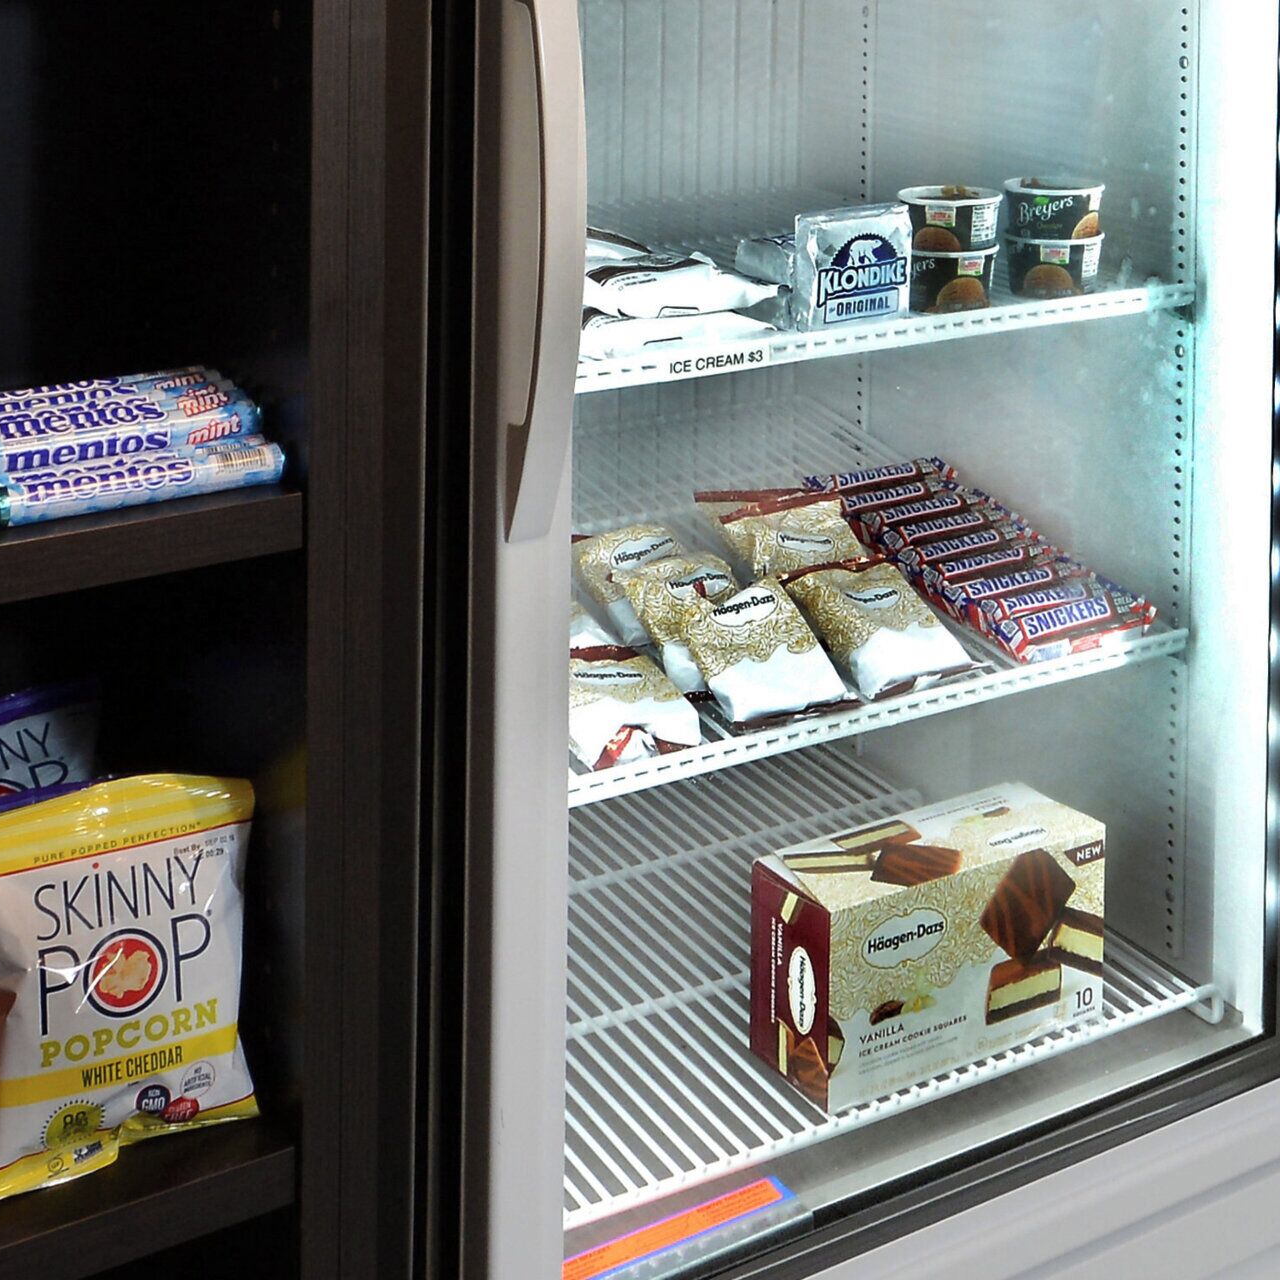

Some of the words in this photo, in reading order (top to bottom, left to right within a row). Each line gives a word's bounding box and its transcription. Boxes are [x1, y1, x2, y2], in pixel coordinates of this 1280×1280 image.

[1019, 195, 1075, 225] Breyers
[819, 259, 908, 302] KLONDIKE
[836, 296, 891, 317] ORIGINAL
[669, 360, 692, 375] ICE
[695, 353, 745, 372] CREAM
[748, 349, 764, 364] $3
[186, 412, 241, 446] mint
[5, 429, 169, 473] mentos
[25, 459, 193, 502] mentos
[969, 568, 1051, 598] SNICKERS
[1026, 597, 1109, 635] SNICKERS
[33, 851, 65, 864] PURE
[68, 839, 118, 858] POPPED
[1076, 843, 1102, 862] NEW
[33, 854, 202, 941] SKINNY
[868, 921, 945, 954] Häagen-Dazs
[38, 912, 210, 1036] POP
[1075, 987, 1094, 1008] 10
[41, 998, 219, 1068] POPCORN
[859, 1024, 905, 1044] VANILLA
[874, 1040, 900, 1054] CREAM
[81, 1058, 123, 1088] WHITE
[126, 1046, 183, 1079] CHEDDAR
